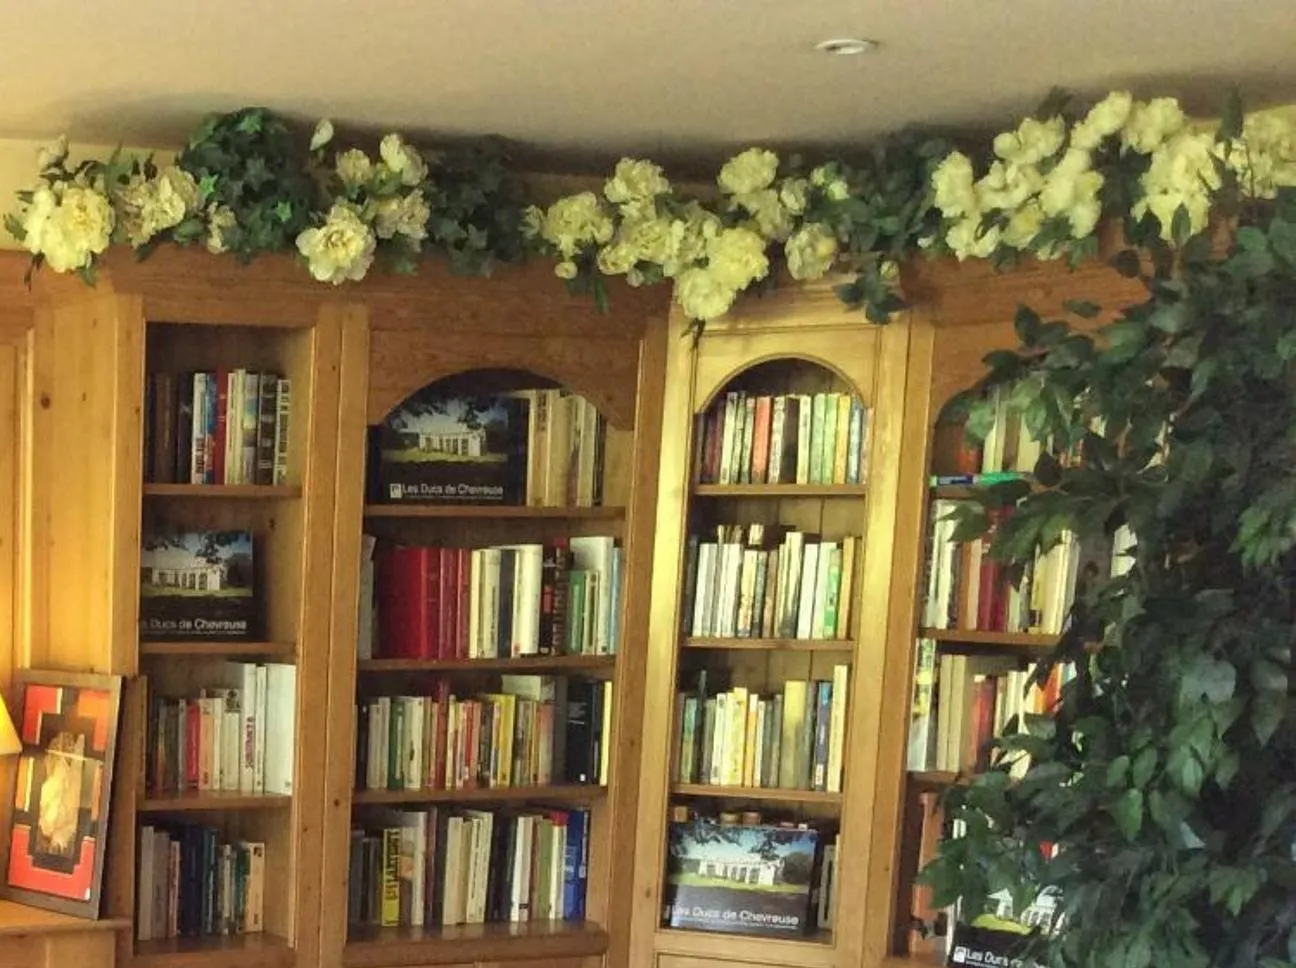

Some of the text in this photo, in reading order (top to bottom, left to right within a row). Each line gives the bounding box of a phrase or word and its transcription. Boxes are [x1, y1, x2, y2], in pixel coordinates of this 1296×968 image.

[402, 483, 504, 495] Les Ducs de Chevreuse
[194, 617, 247, 630] Chevreuse
[673, 904, 690, 917] Les
[691, 906, 720, 918] Ducs
[722, 908, 737, 921] de
[739, 909, 800, 925] Chevreuse
[966, 948, 983, 962] Les
[984, 951, 1009, 967] Ducs
